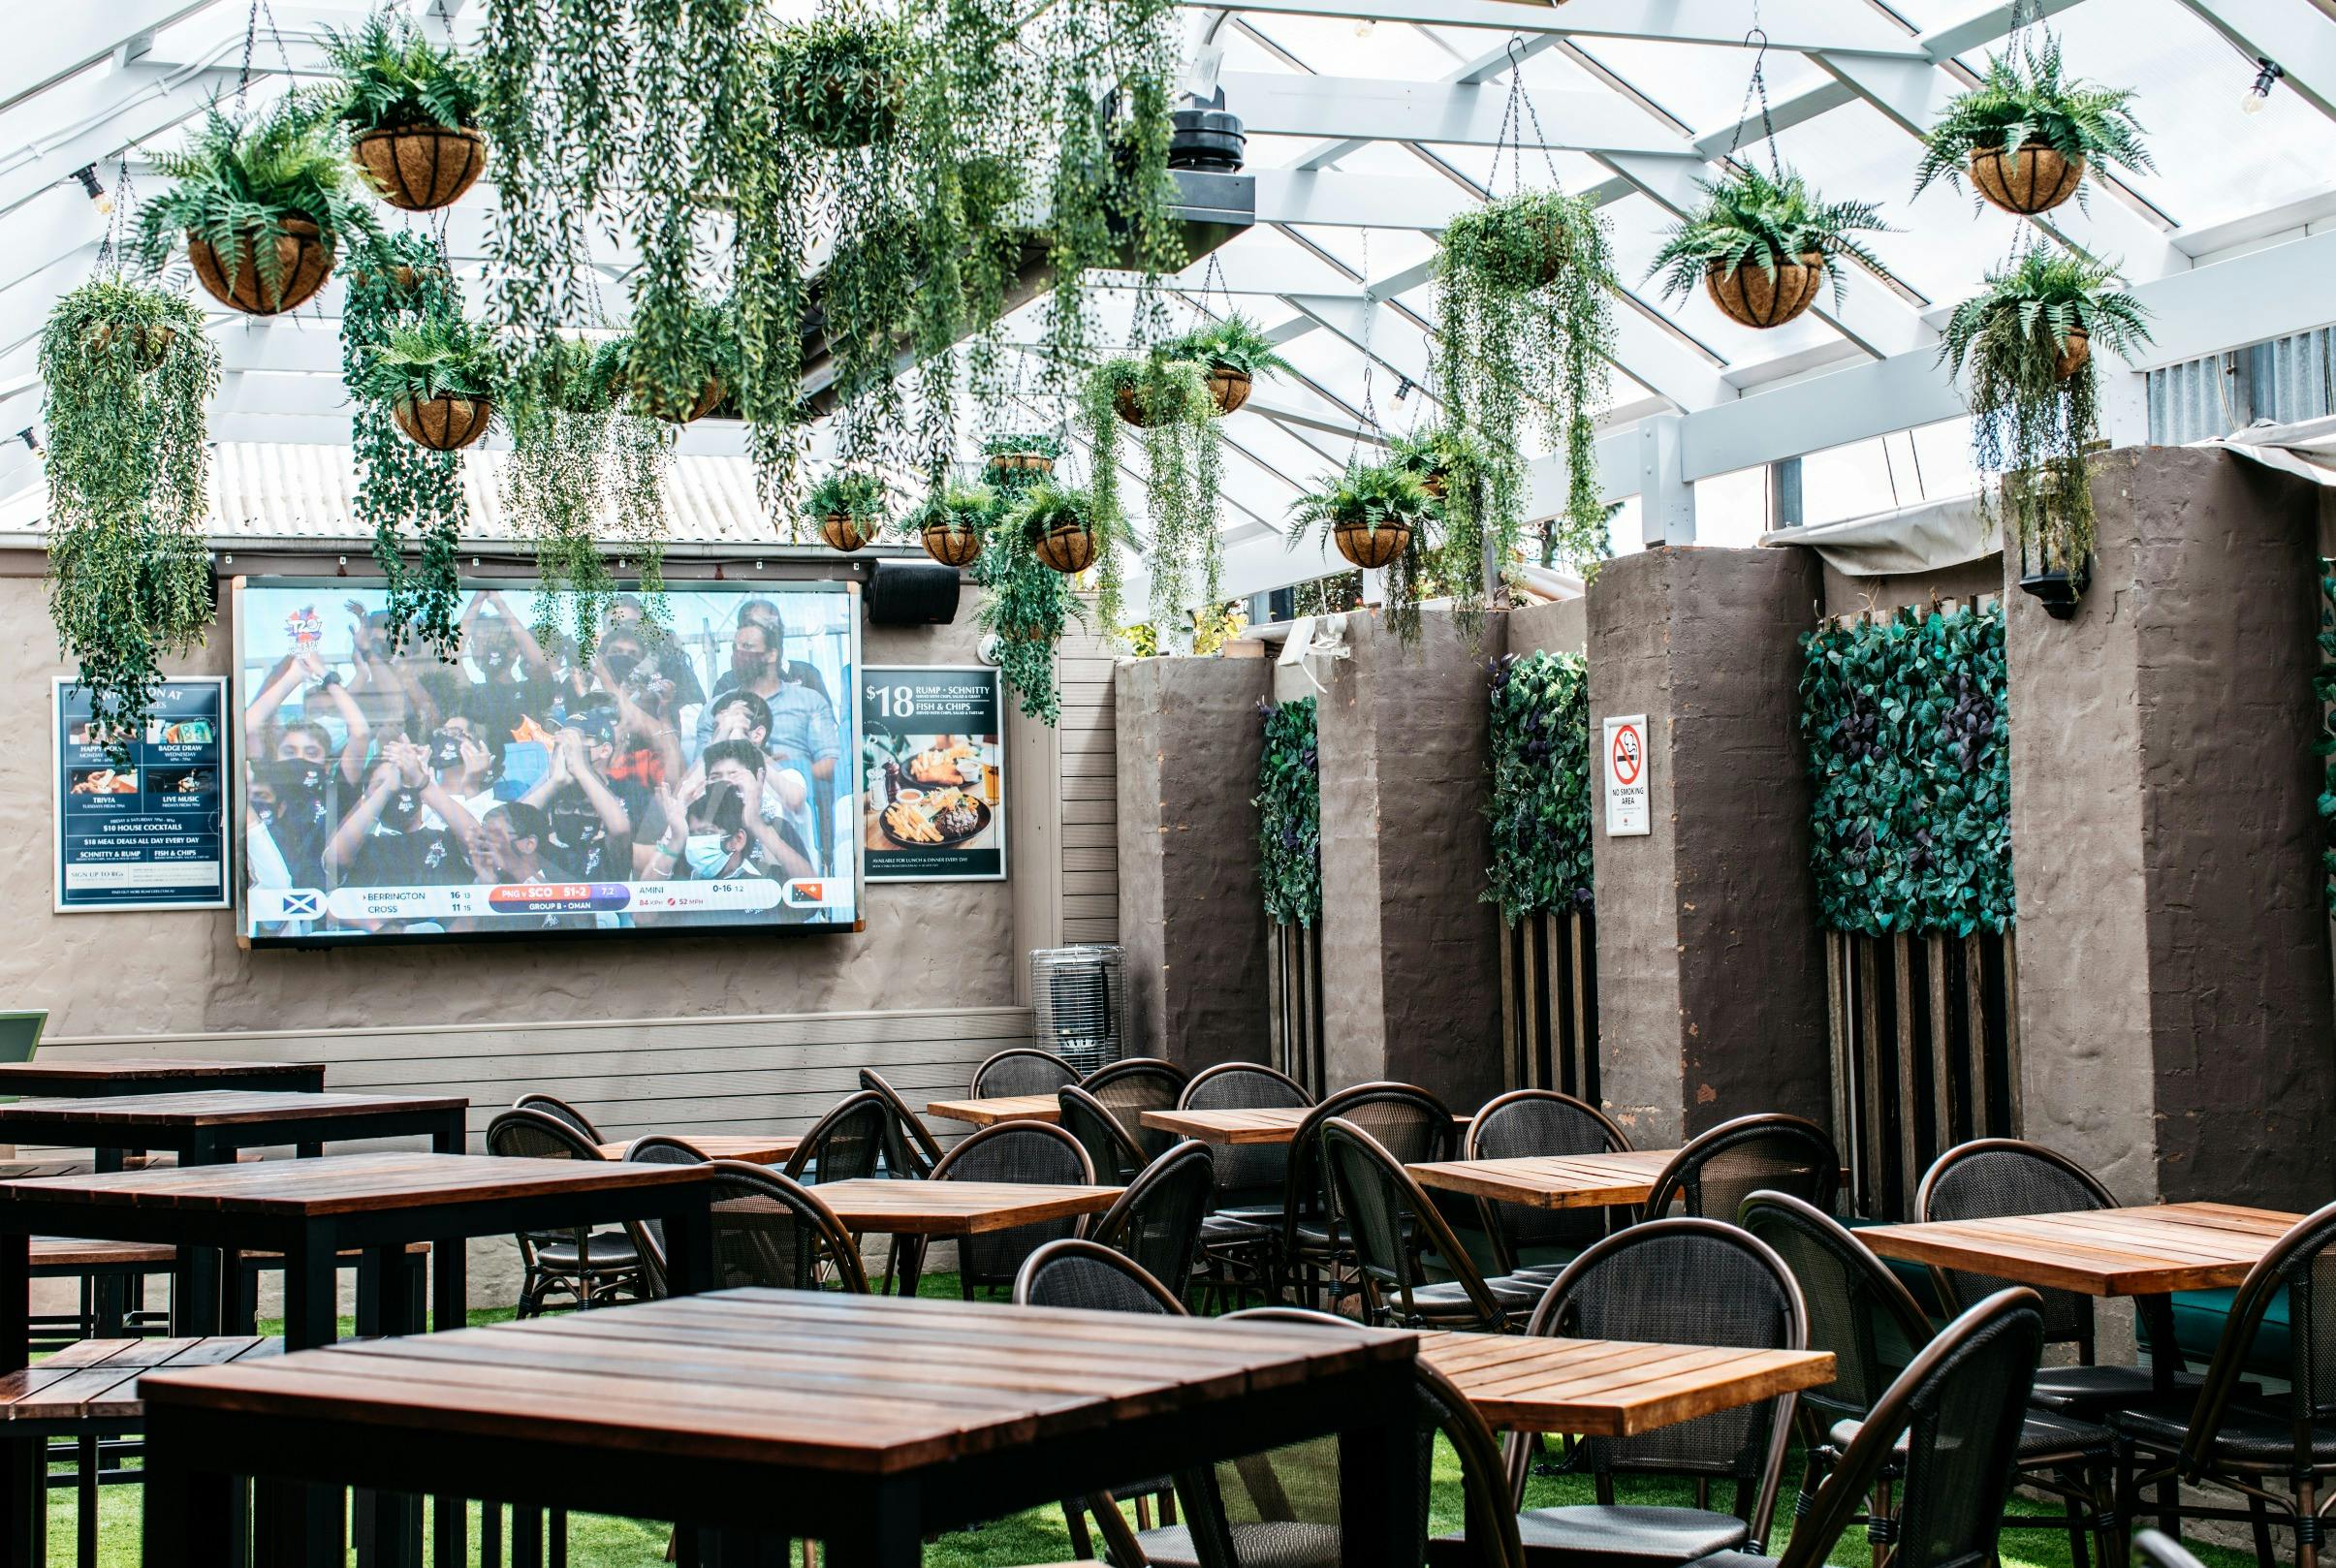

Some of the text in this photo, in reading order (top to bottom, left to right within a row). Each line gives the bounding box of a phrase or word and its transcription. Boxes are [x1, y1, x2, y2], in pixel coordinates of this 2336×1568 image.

[146, 687, 167, 698] ON
[168, 689, 183, 701] AT
[867, 685, 915, 717] $18
[1620, 787, 1644, 796] SMOKING
[1622, 797, 1634, 805] AREA
[502, 890, 521, 898] PNG
[528, 888, 552, 897] SCO
[563, 887, 586, 896] 51-2
[712, 884, 732, 893] 0-16
[368, 892, 426, 901] BERRINGTON
[368, 905, 397, 914] CROSS
